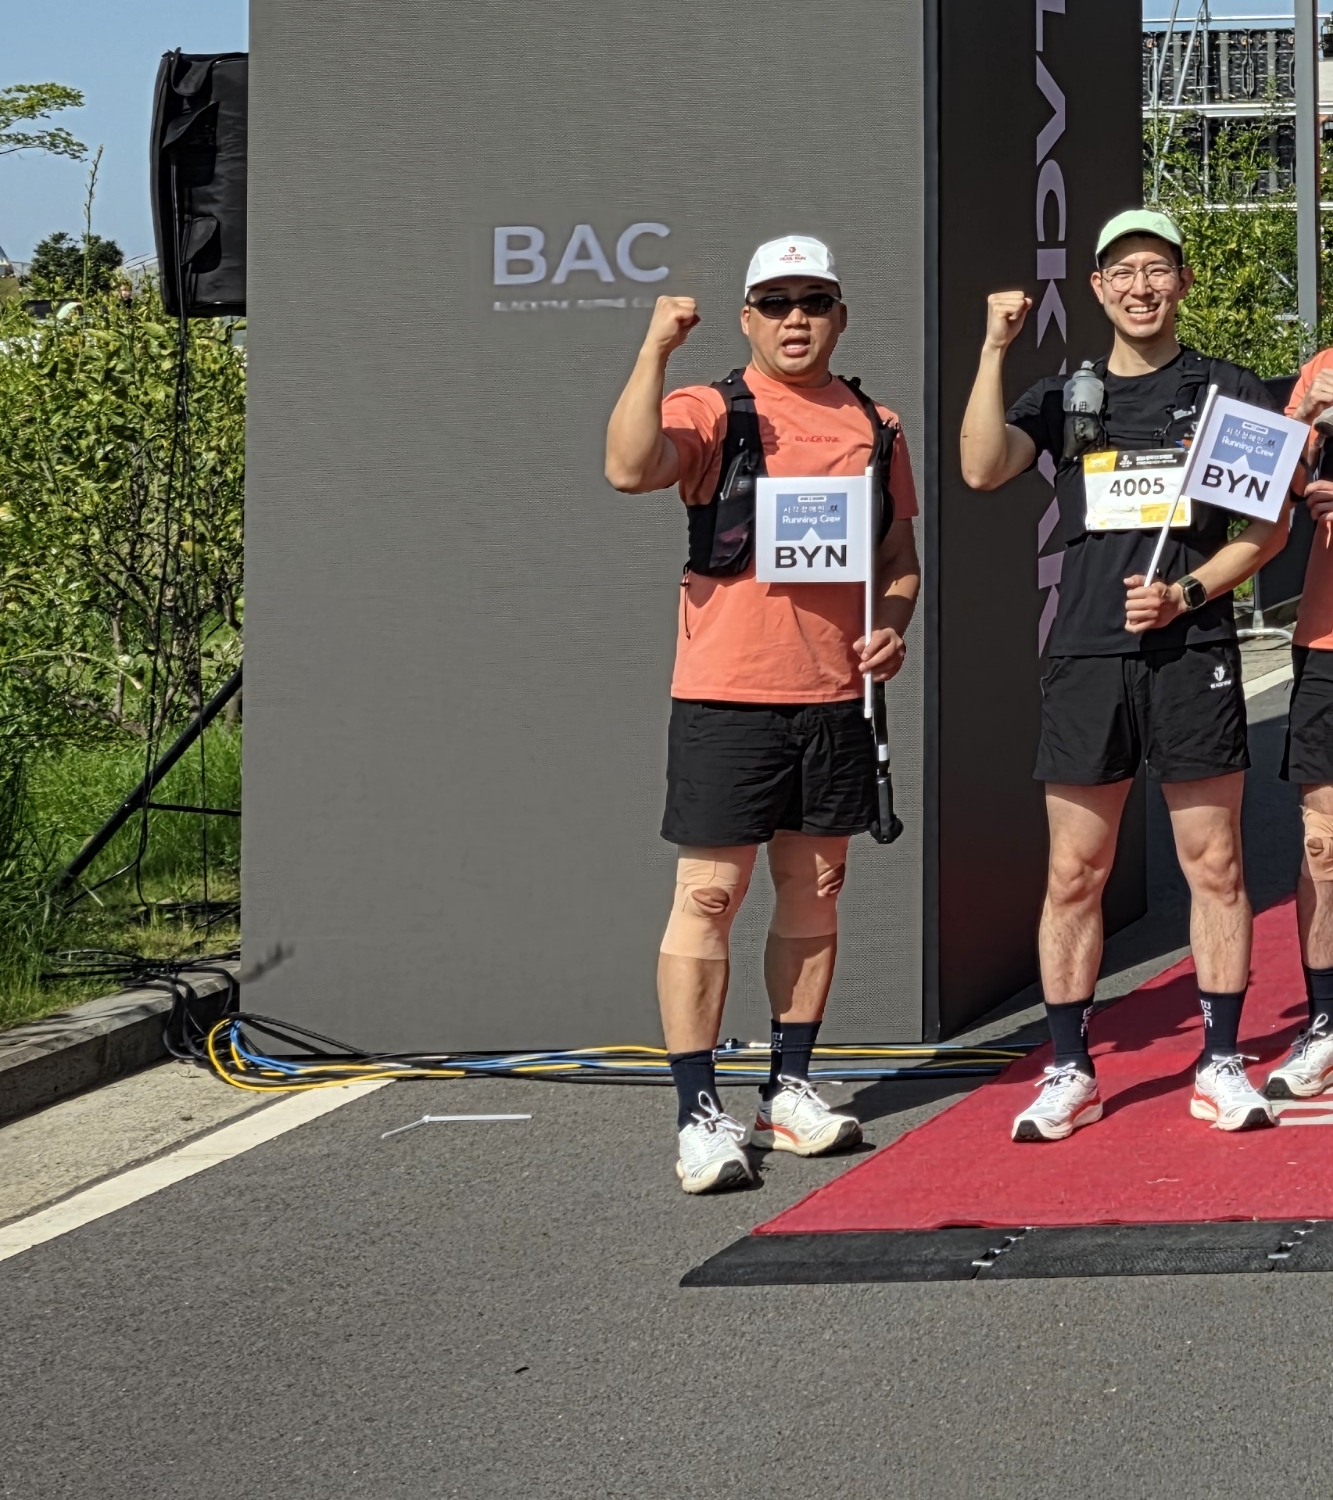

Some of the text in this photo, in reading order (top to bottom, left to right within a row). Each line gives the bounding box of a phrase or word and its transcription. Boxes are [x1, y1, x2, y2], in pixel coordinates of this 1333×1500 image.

[493, 222, 670, 285] BAC
[1109, 477, 1165, 497] 4005
[1200, 463, 1271, 503] BYN
[775, 544, 847, 569] BYN
[1199, 998, 1213, 1029] BAC
